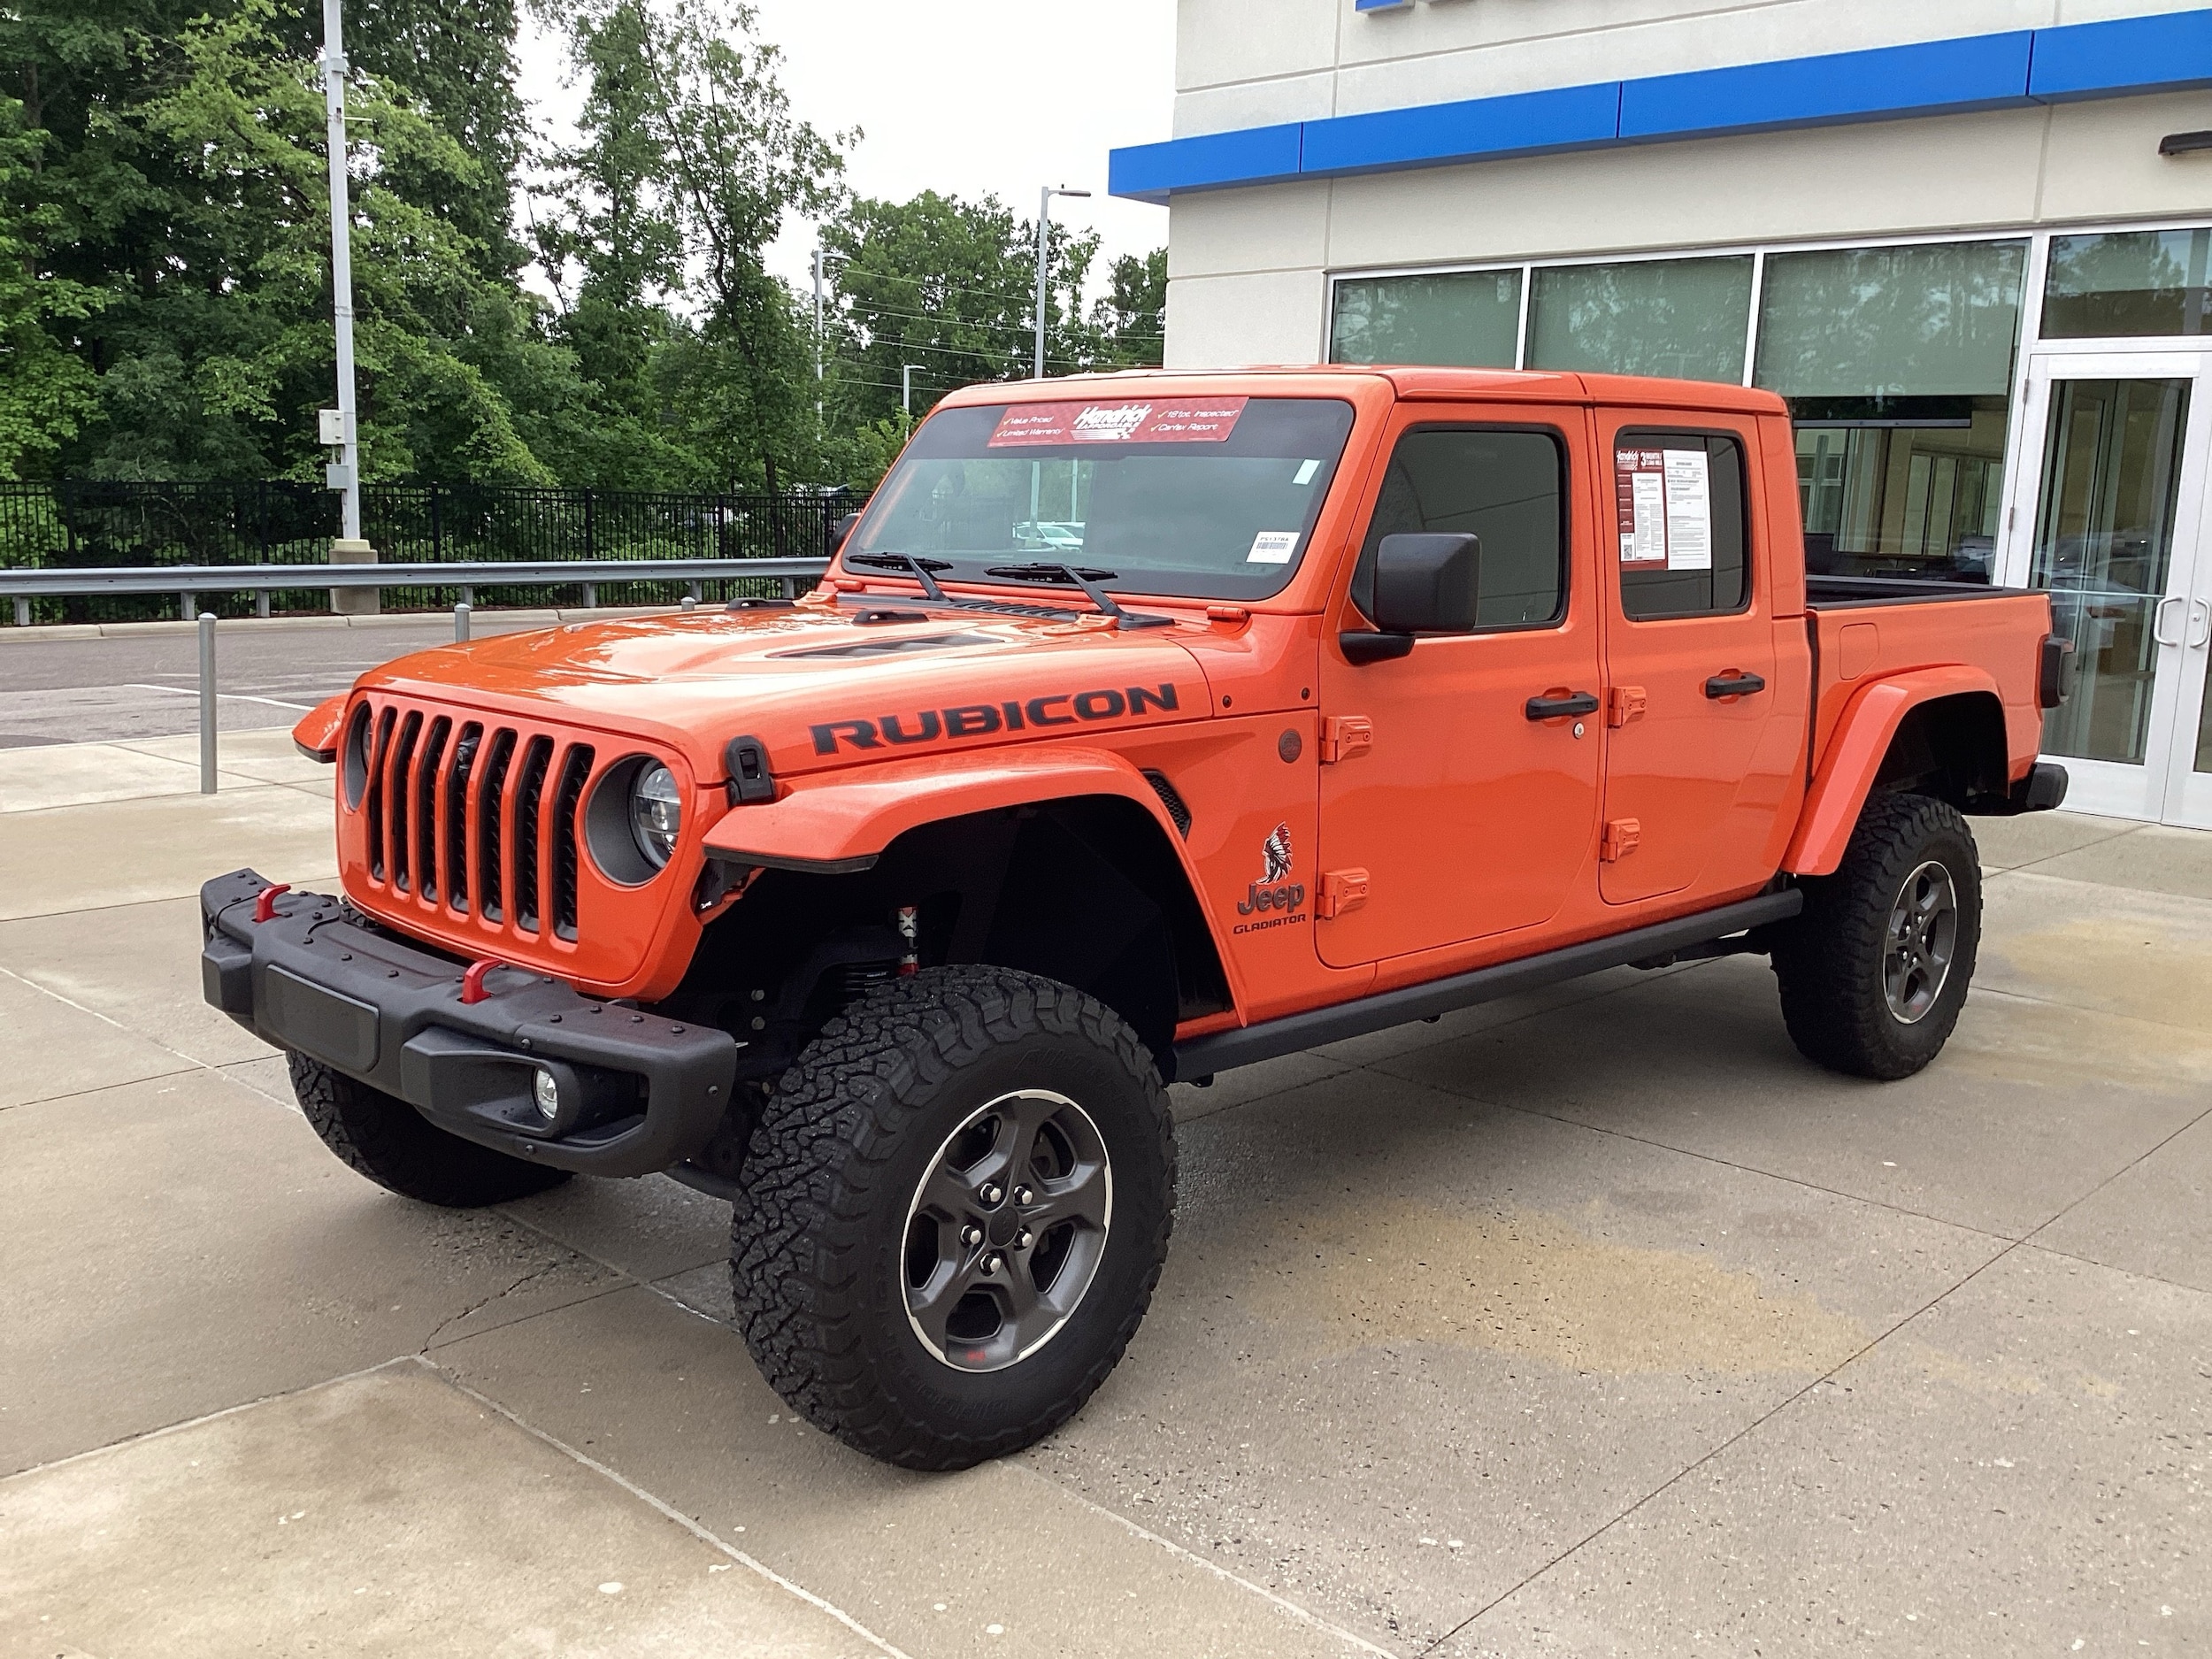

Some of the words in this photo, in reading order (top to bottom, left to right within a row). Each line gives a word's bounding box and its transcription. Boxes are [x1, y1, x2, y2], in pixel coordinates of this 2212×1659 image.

[1073, 404, 1153, 425] Hendrick
[1002, 428, 1028, 437] Limited
[1187, 423, 1218, 432] Report
[808, 683, 1179, 756] RUBICON
[1238, 882, 1305, 916] Jeep
[1233, 913, 1307, 935] GLADIATOR
